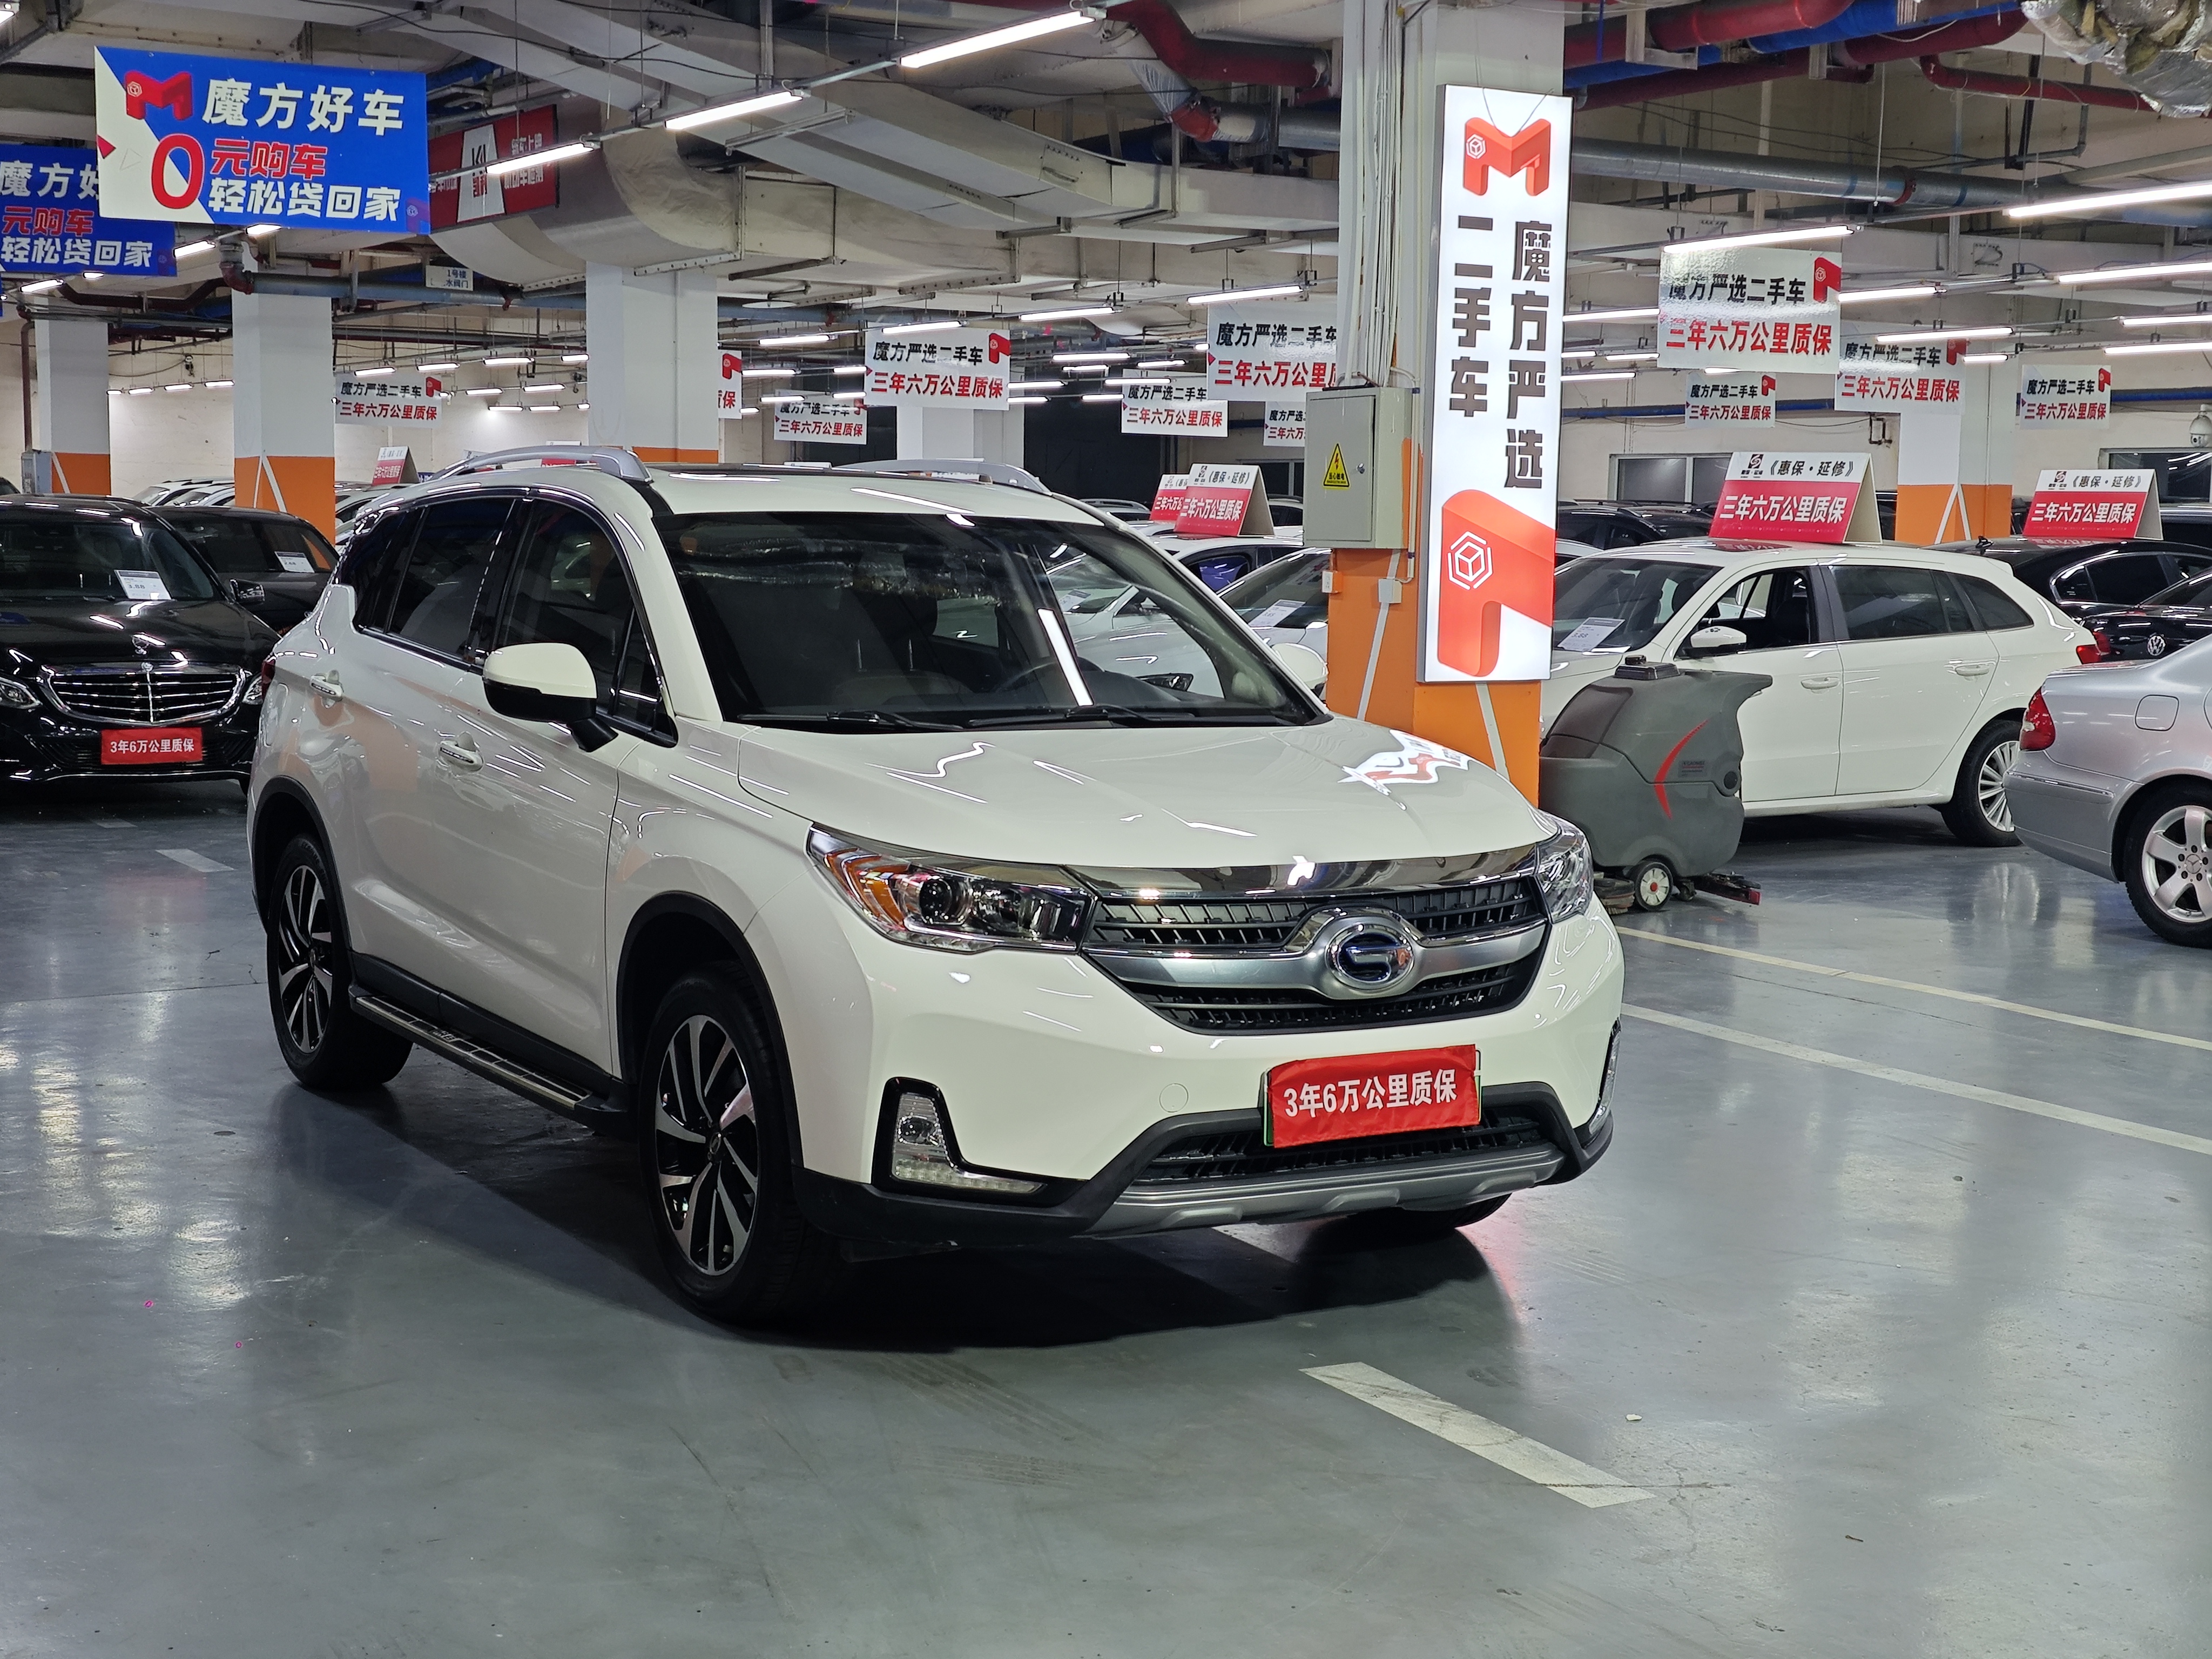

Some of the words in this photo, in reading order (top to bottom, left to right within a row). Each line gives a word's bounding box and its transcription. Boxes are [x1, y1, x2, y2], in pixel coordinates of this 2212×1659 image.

[202, 78, 404, 136] 魔方好车
[210, 138, 328, 180] 元购车
[208, 177, 401, 221] 轻松贷回家
[2, 206, 95, 237] 元购车
[1, 235, 153, 267] 轻松贷回家
[1669, 274, 1806, 305] 魔方严选二手车
[1449, 215, 1493, 417] 二手车
[1666, 320, 1832, 356] 三年六万公里质保
[873, 341, 983, 366] 魔方严选二手车
[1504, 220, 1552, 489] 魔方严选
[1845, 342, 1941, 367] 魔方严选二手车
[341, 382, 422, 398] 魔方严选二手车
[871, 372, 1003, 398] 三年六万公里质保
[1128, 385, 1207, 401] 魔方严选二手车
[1690, 384, 1758, 398] 魔方严选二手车
[1842, 375, 1960, 402] 三年六万公里质保
[2027, 379, 2095, 394] 魔方严选二手车
[340, 402, 437, 420] 三年六万公里质保
[780, 402, 850, 416] 魔方严选二手车
[1127, 407, 1223, 427] 三年六万公里质保
[1269, 410, 1306, 421] 魔方严选
[1689, 405, 1771, 420] 三年六万公里质保
[2025, 403, 2106, 420] 三年六万公里质保
[779, 419, 863, 436] 三年六万公里质保
[1268, 427, 1306, 440] 三年六万
[1180, 497, 1243, 521] 三年六万公里质保
[1719, 494, 1847, 524] 三年六万公里质保
[2031, 502, 2137, 524] 三年六万公里质保
[110, 738, 194, 754] 3年6万公里质保
[1284, 1069, 1457, 1118] 3年6万公里质保
